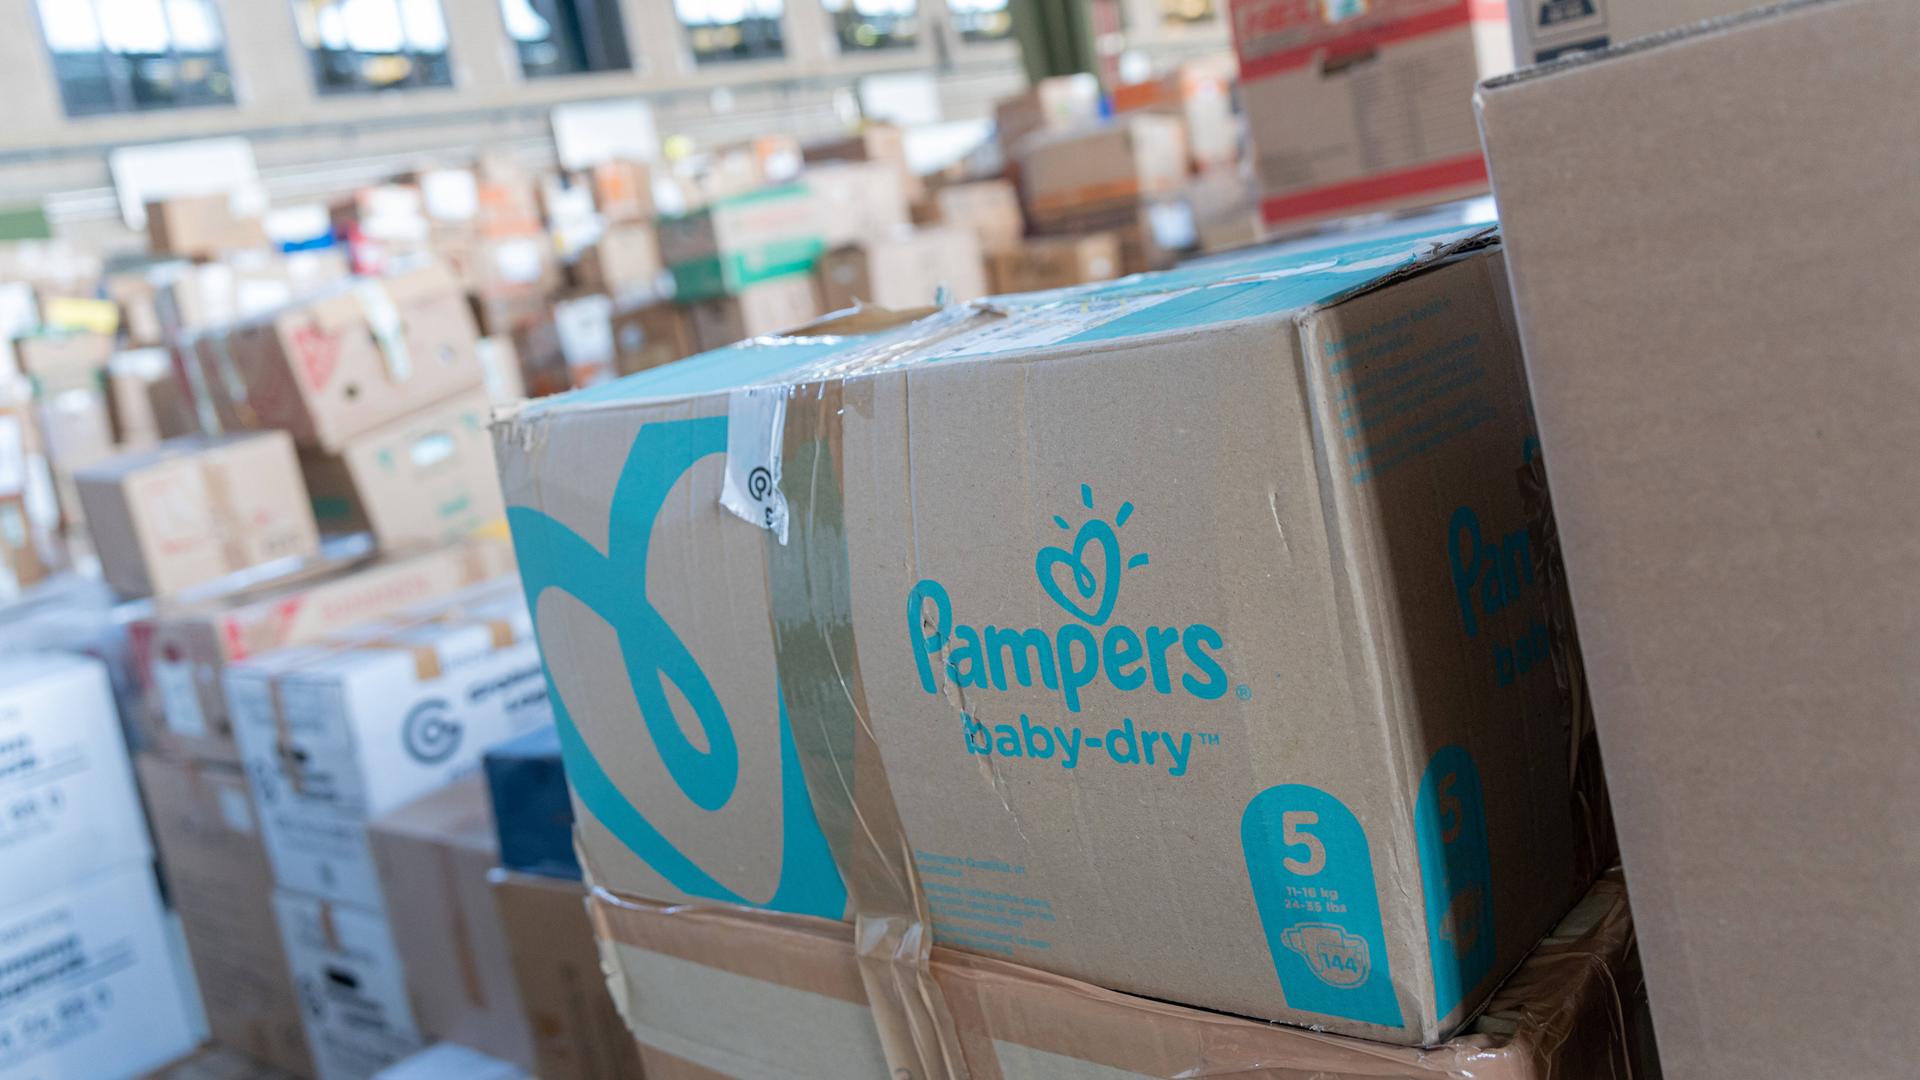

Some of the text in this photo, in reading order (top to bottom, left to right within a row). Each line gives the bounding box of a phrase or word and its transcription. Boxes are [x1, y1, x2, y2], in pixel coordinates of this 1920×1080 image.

[906, 578, 1229, 714] Pampers
[960, 712, 1192, 777] baby-dry
[1439, 772, 1462, 844] 5
[1282, 811, 1326, 876] 5
[1286, 886, 1339, 901] 11-16 kg
[1326, 902, 1348, 913] lbs
[1321, 952, 1359, 974] 144
